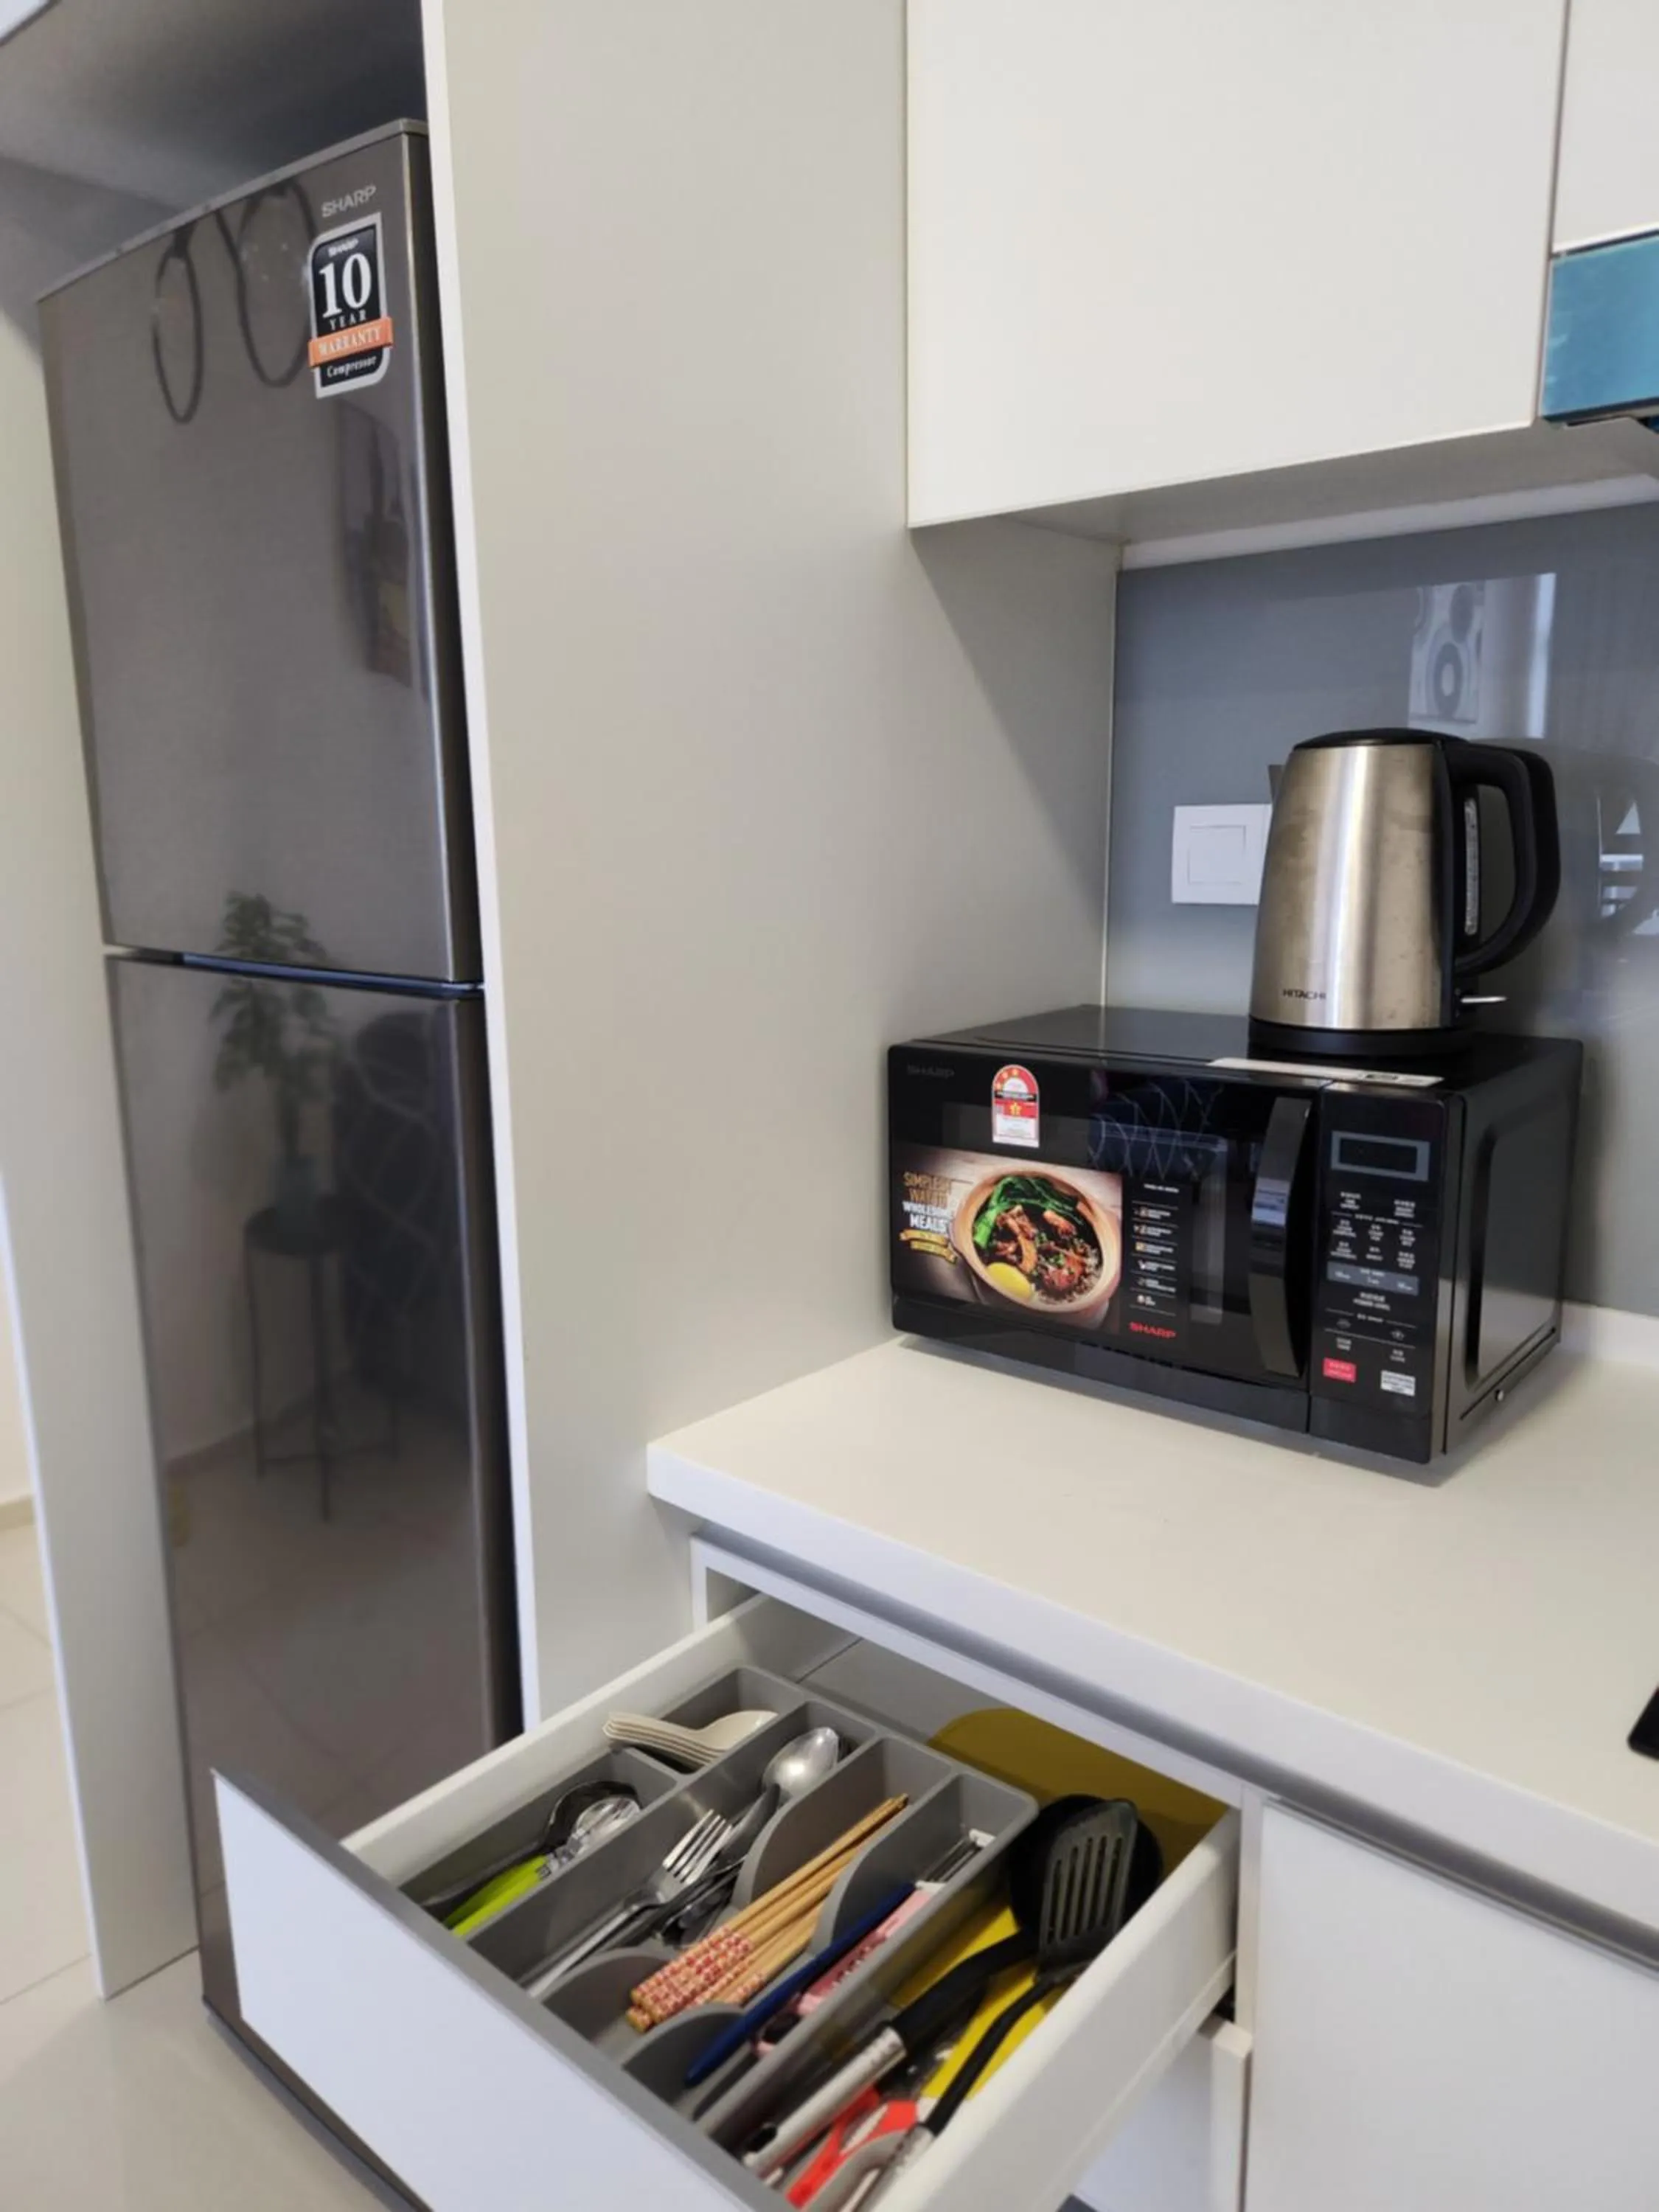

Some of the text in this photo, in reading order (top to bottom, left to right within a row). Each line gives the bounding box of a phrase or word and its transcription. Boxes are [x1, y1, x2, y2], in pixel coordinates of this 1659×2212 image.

[321, 185, 377, 218] SHARP
[319, 252, 372, 319] 10
[329, 314, 367, 331] YEAR
[318, 327, 382, 355] WARRANTY
[327, 355, 378, 378] Compressor
[1282, 989, 1326, 1000] HITACHI
[907, 1065, 955, 1080] SHARP
[909, 1214, 947, 1234] MEALS
[1129, 1321, 1177, 1338] SHARP
